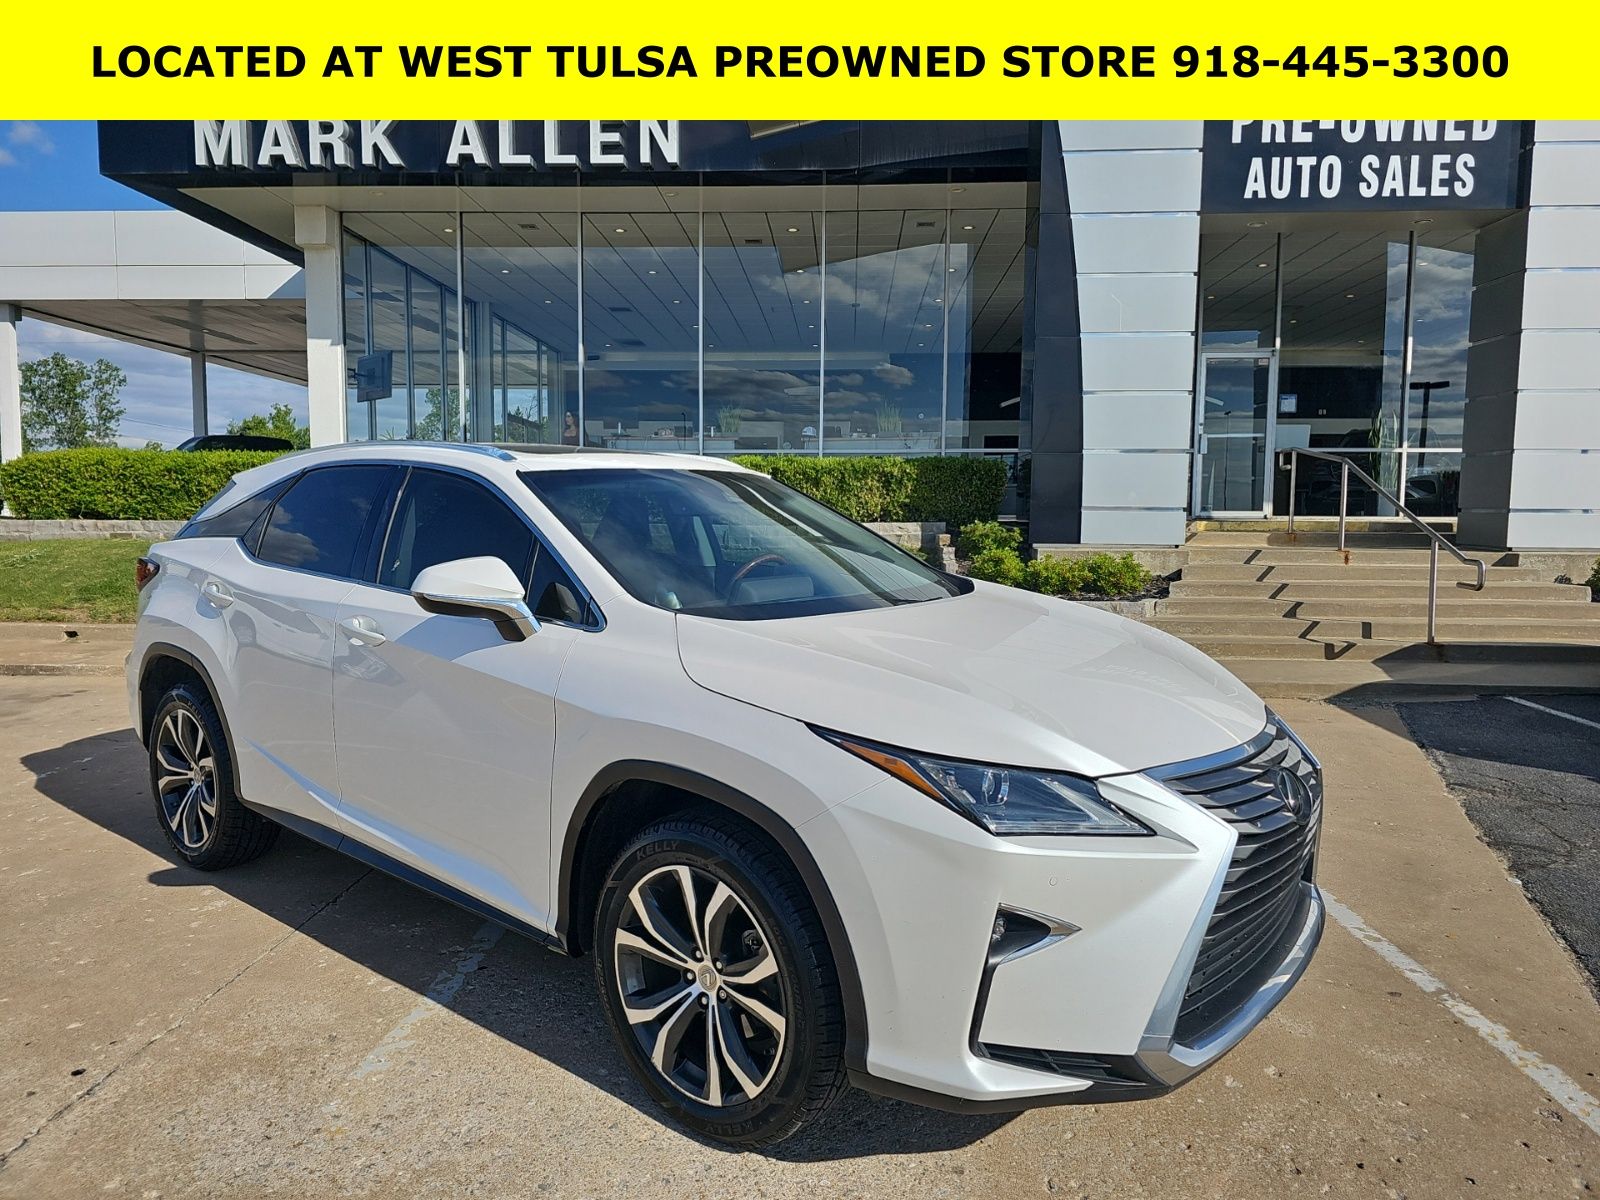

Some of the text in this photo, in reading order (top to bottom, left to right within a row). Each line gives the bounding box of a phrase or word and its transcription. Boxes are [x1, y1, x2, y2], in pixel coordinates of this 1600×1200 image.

[193, 120, 681, 168] MARK ALLEN
[1243, 153, 1476, 199] AUTO SALES
[635, 840, 681, 861] KELLY
